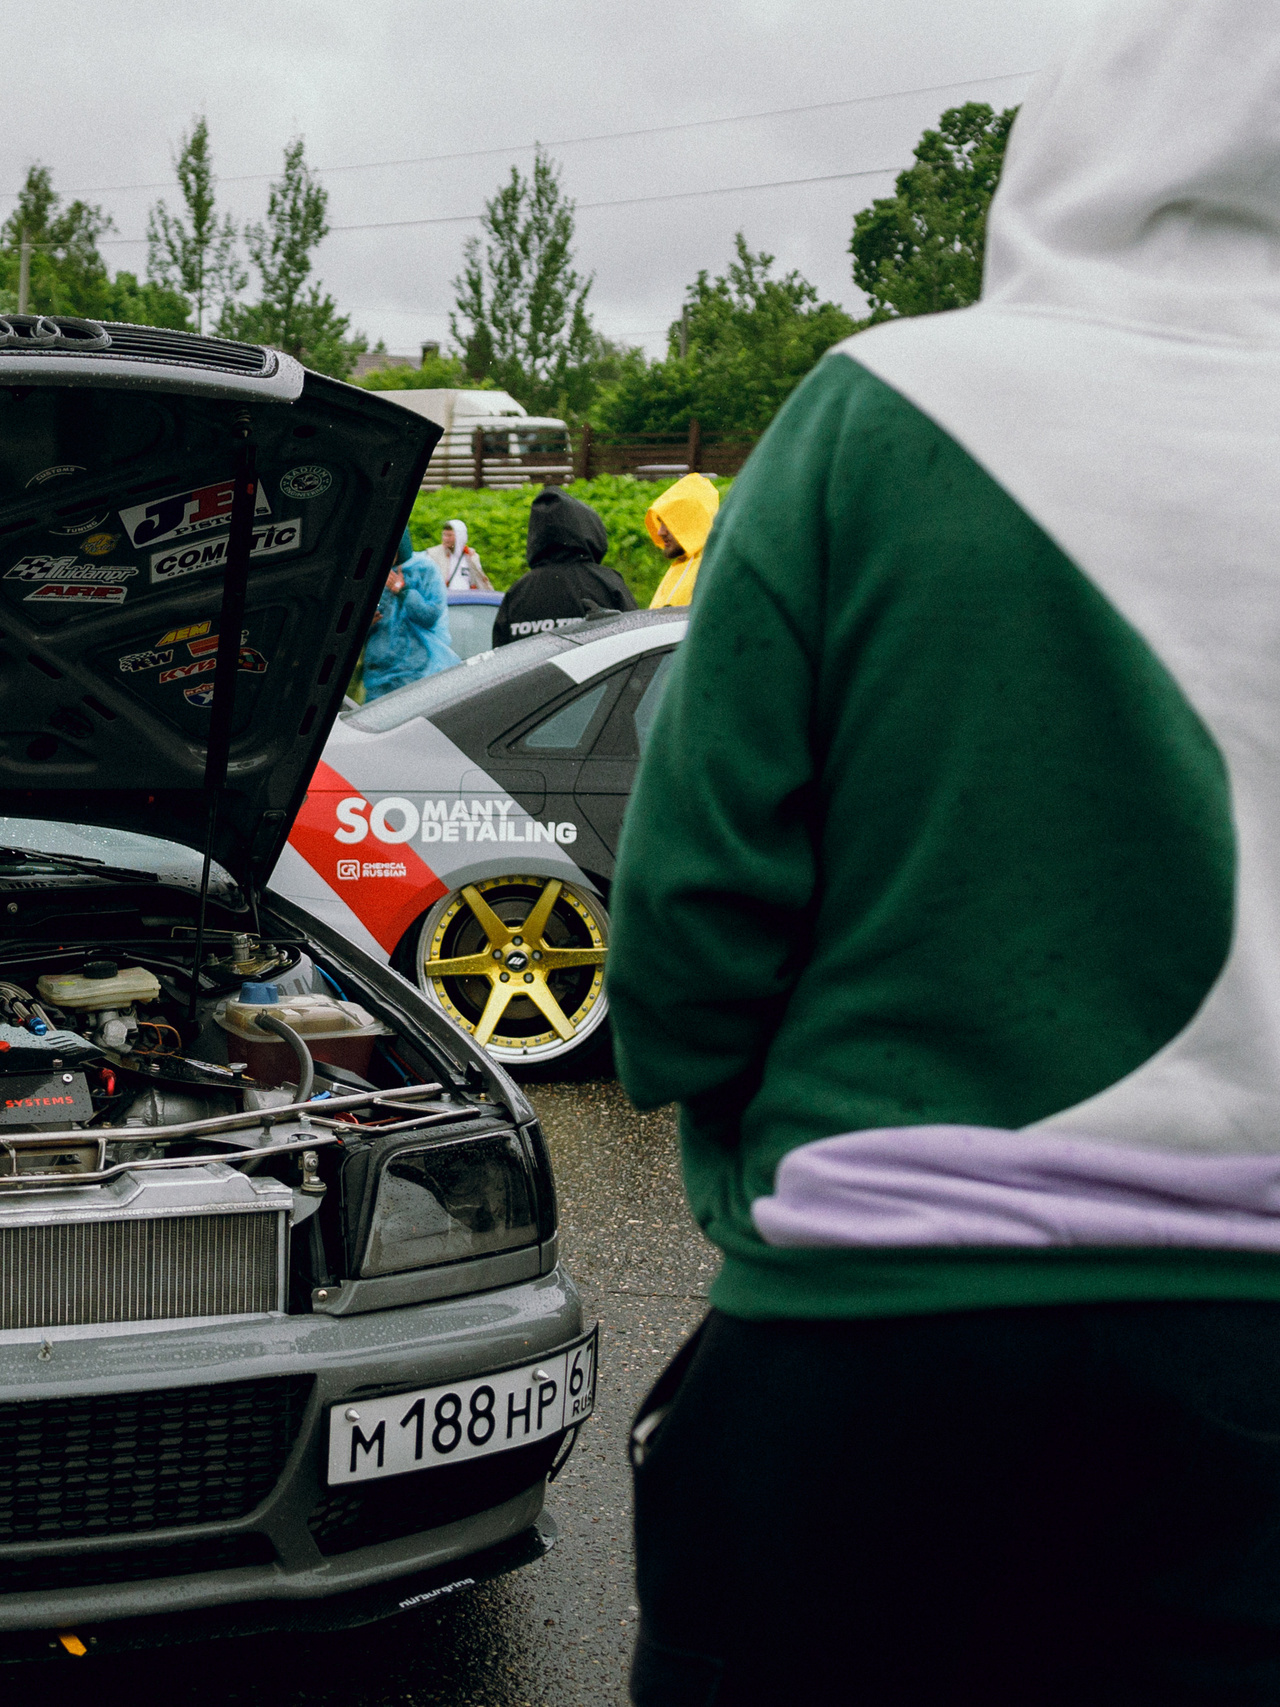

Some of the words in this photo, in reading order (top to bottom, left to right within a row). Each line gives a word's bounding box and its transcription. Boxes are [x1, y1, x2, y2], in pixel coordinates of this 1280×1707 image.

[35, 467, 75, 481] CUSTOMS
[66, 520, 98, 533] TUNING
[156, 526, 297, 574] COMTIC
[34, 585, 124, 597] ARP
[158, 621, 210, 646] AEM
[510, 619, 555, 636] TOYO
[131, 651, 172, 671] KW
[161, 659, 216, 683] KYB
[421, 800, 515, 822] MANY
[333, 797, 420, 844] SO
[421, 821, 578, 844] DETAILING
[362, 862, 406, 870] CHEMICAL
[362, 869, 407, 878] RUSSIAN
[5, 1095, 74, 1109] SYSTEMS
